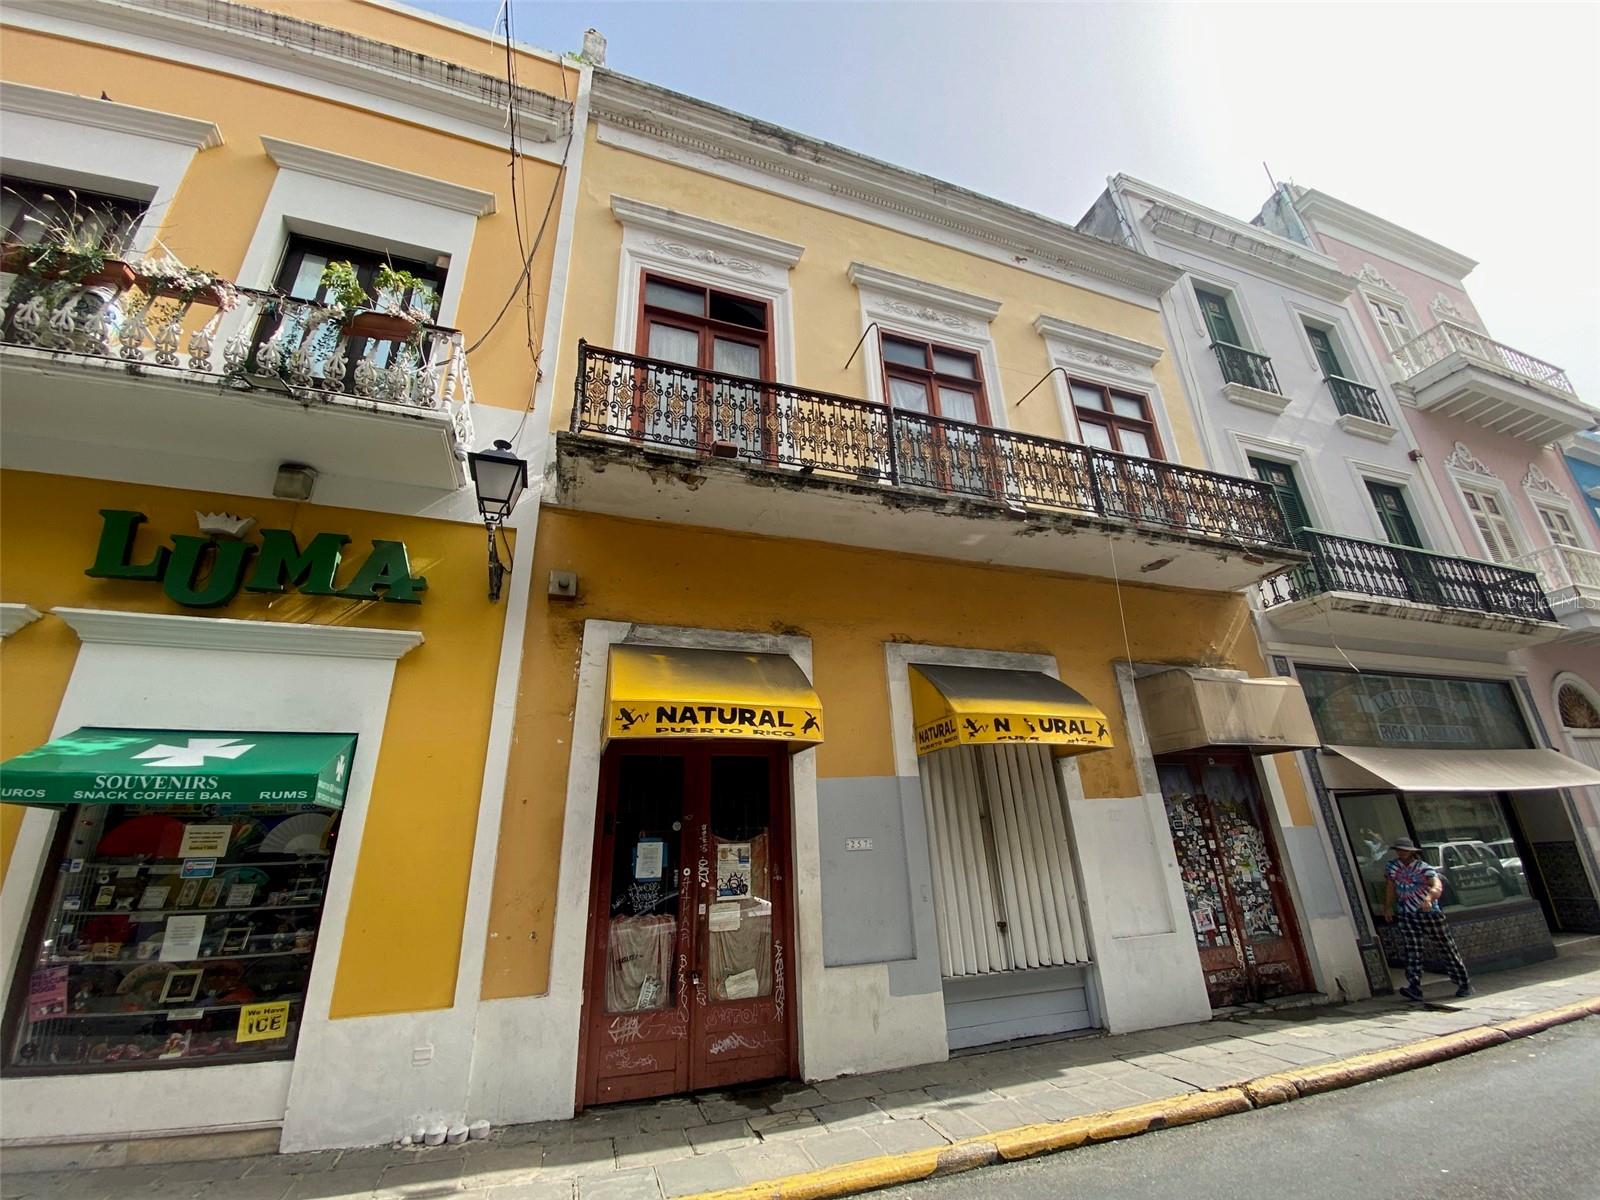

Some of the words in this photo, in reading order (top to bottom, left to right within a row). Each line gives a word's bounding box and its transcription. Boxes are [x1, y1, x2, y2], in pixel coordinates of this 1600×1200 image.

[85, 509, 428, 608] LUMA
[655, 705, 794, 728] NATURAL
[655, 726, 743, 734] PUERTO
[752, 728, 796, 737] RICO
[918, 719, 957, 744] NATURAL
[93, 774, 220, 790] SOUVENIRS
[72, 790, 128, 799] SNACK
[132, 791, 195, 800] COFFEE
[200, 791, 232, 800] BAR
[259, 790, 308, 799] RUMS
[263, 1007, 286, 1015] Have
[248, 1014, 282, 1034] ICE
